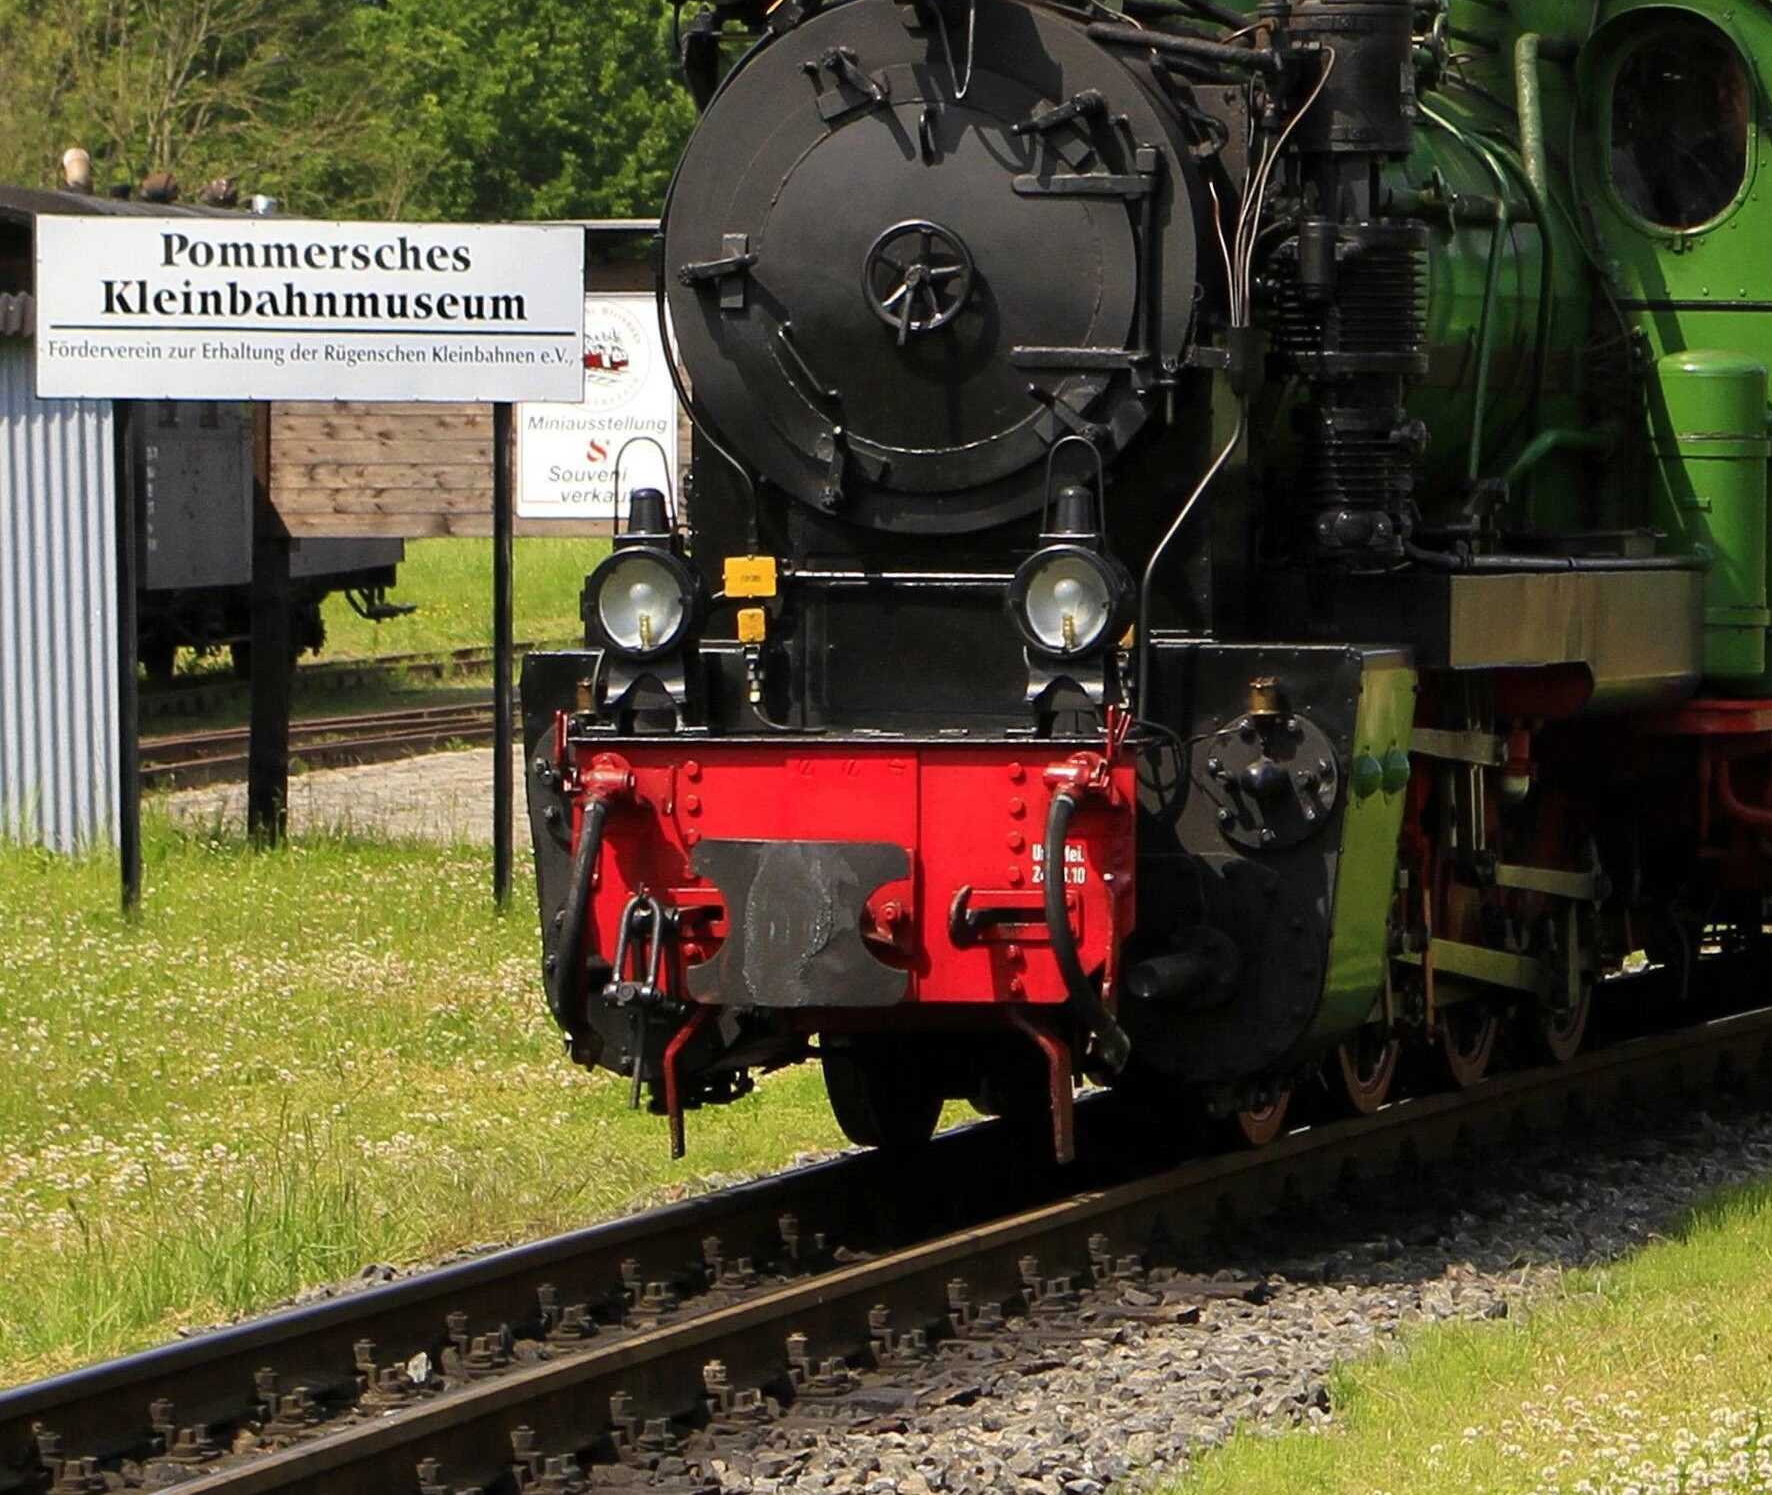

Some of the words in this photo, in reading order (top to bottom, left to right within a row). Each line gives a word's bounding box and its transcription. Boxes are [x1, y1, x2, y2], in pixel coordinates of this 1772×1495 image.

[160, 233, 472, 271] Pommersches
[101, 279, 527, 321] Kleinbahnmuseum
[49, 340, 162, 360] Förderverein
[168, 345, 196, 360] zur
[202, 342, 285, 366] Erhaltung
[290, 344, 318, 361] der
[324, 344, 426, 367] Rügenschen
[432, 345, 535, 364] Kleinbahnen
[527, 415, 668, 434] Miniausstellung
